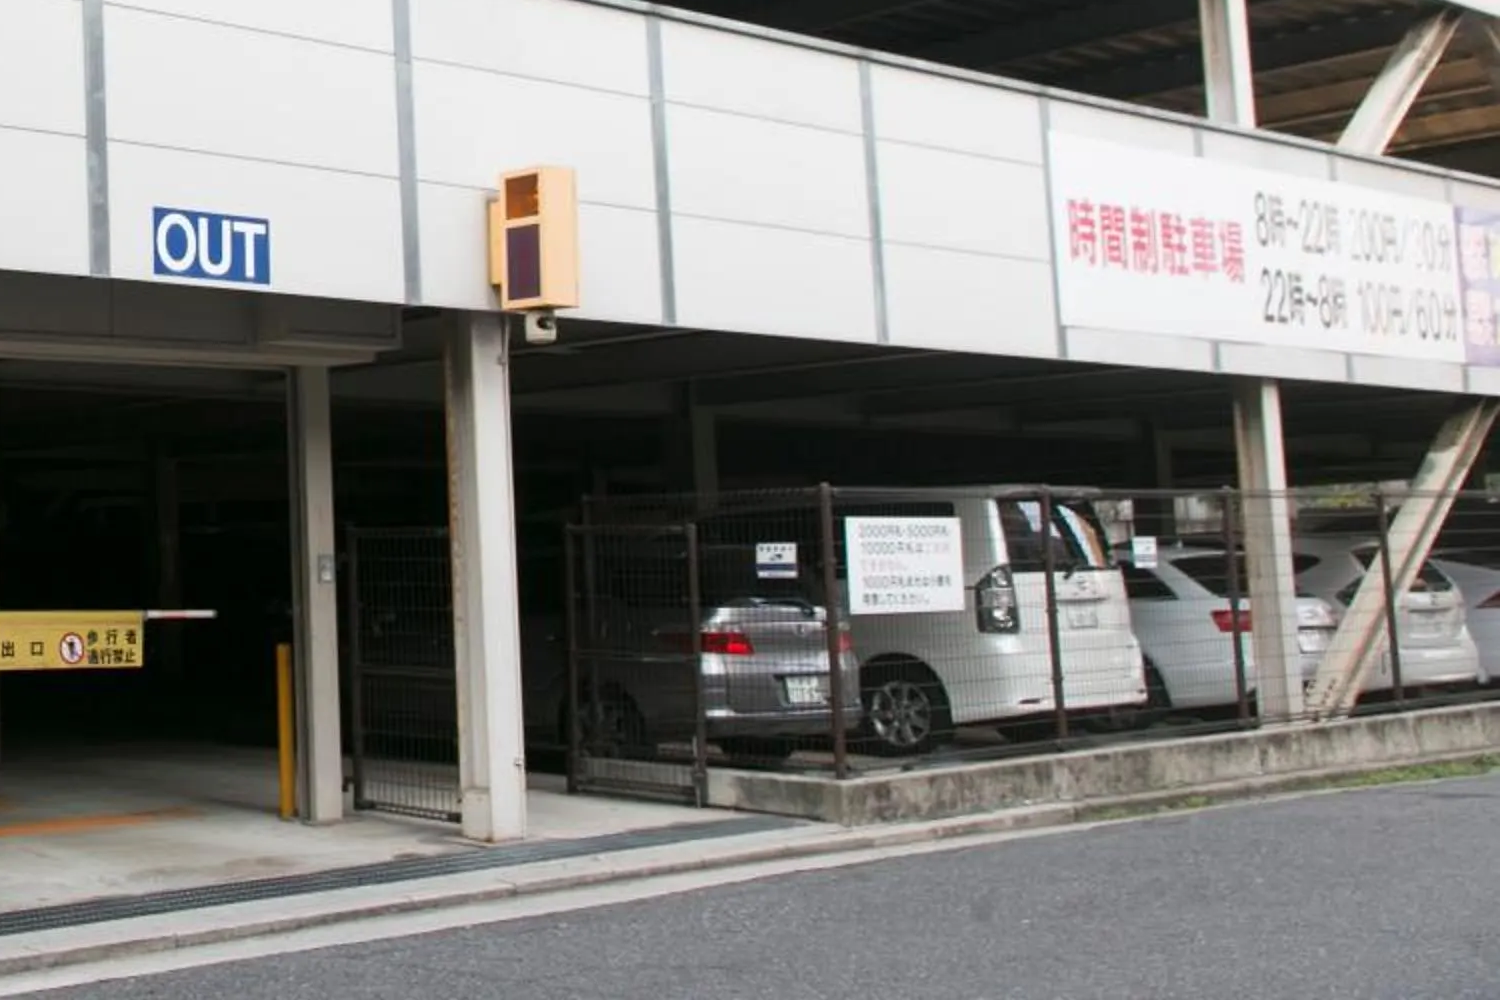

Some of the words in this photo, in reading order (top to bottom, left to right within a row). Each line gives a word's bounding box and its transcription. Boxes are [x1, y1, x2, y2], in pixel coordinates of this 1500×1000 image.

[157, 212, 267, 279] OUT
[1067, 197, 1246, 284] 時間制駐車場
[1, 640, 45, 658] 出口
[86, 648, 136, 665] 通行禁止
